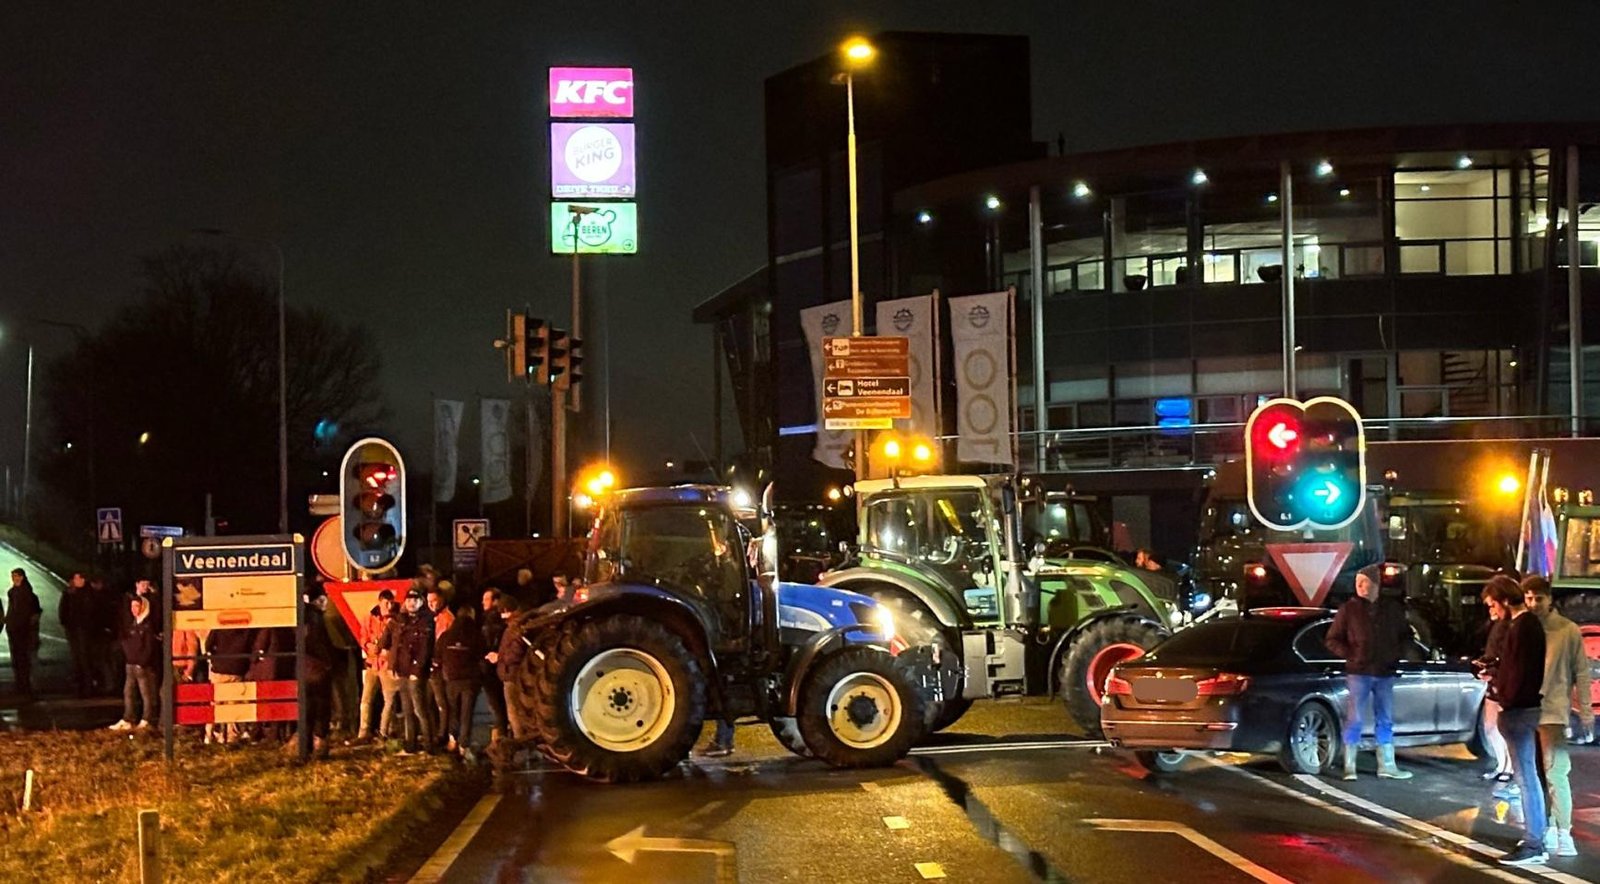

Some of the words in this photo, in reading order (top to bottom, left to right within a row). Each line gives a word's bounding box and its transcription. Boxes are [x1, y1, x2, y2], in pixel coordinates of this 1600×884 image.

[554, 80, 634, 105] KFC
[575, 147, 614, 169] KING
[857, 379, 879, 387] Hotel
[857, 388, 903, 396] Veenendaal
[182, 551, 287, 569] Veenendaal
